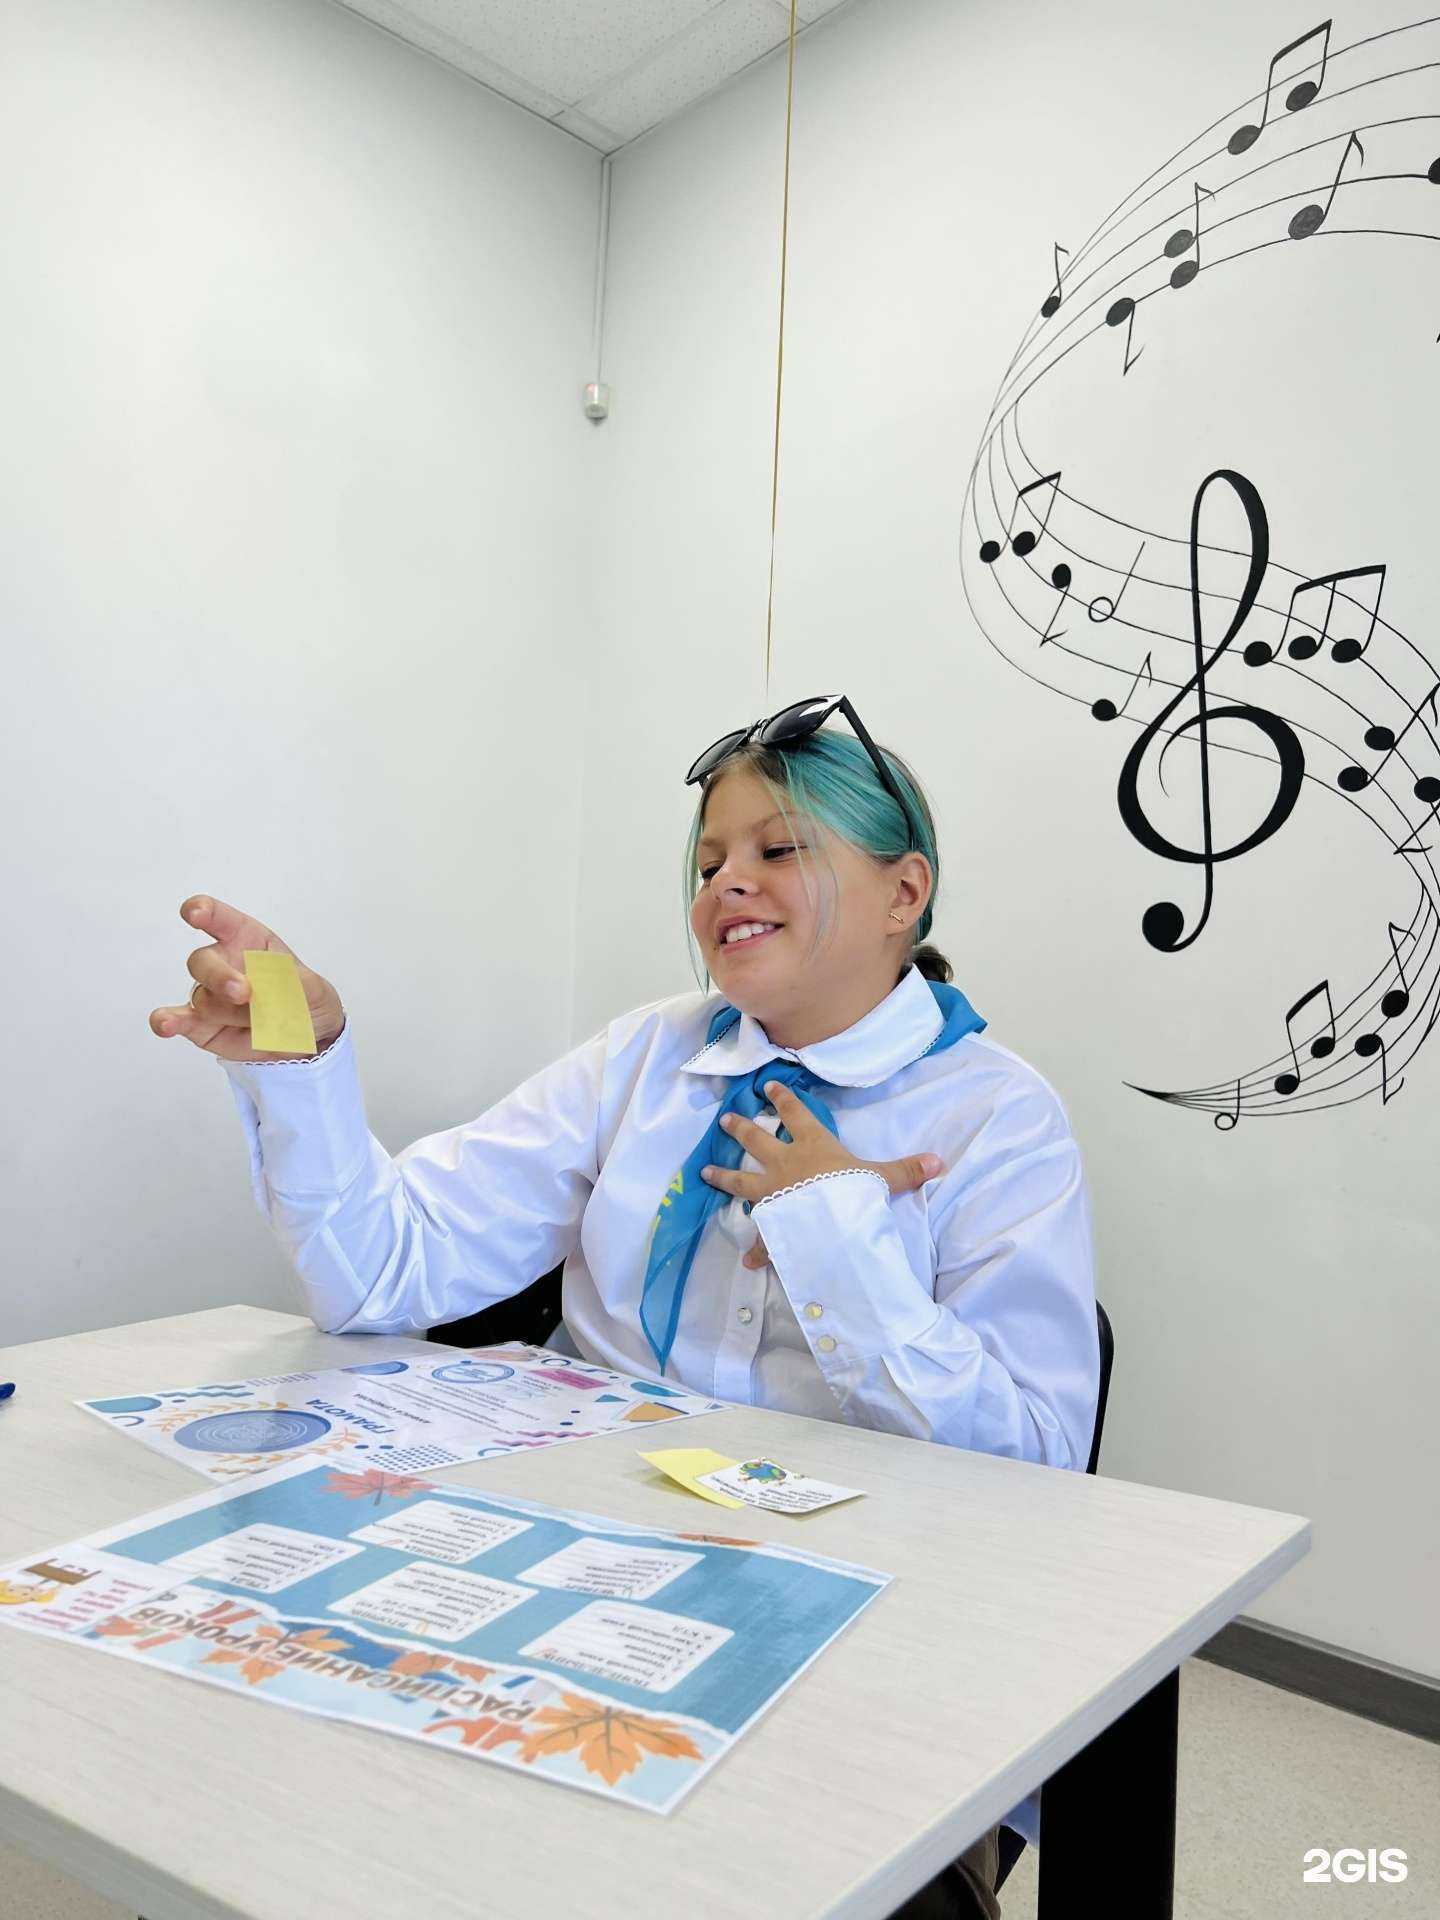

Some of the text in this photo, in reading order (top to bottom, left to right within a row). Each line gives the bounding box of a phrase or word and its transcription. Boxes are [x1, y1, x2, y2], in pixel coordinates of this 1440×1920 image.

[306, 1398, 395, 1434] ГРАМОТА
[128, 1605, 267, 1655] УРОКОВ
[272, 1643, 535, 1723] РАСПИСАНИЕ
